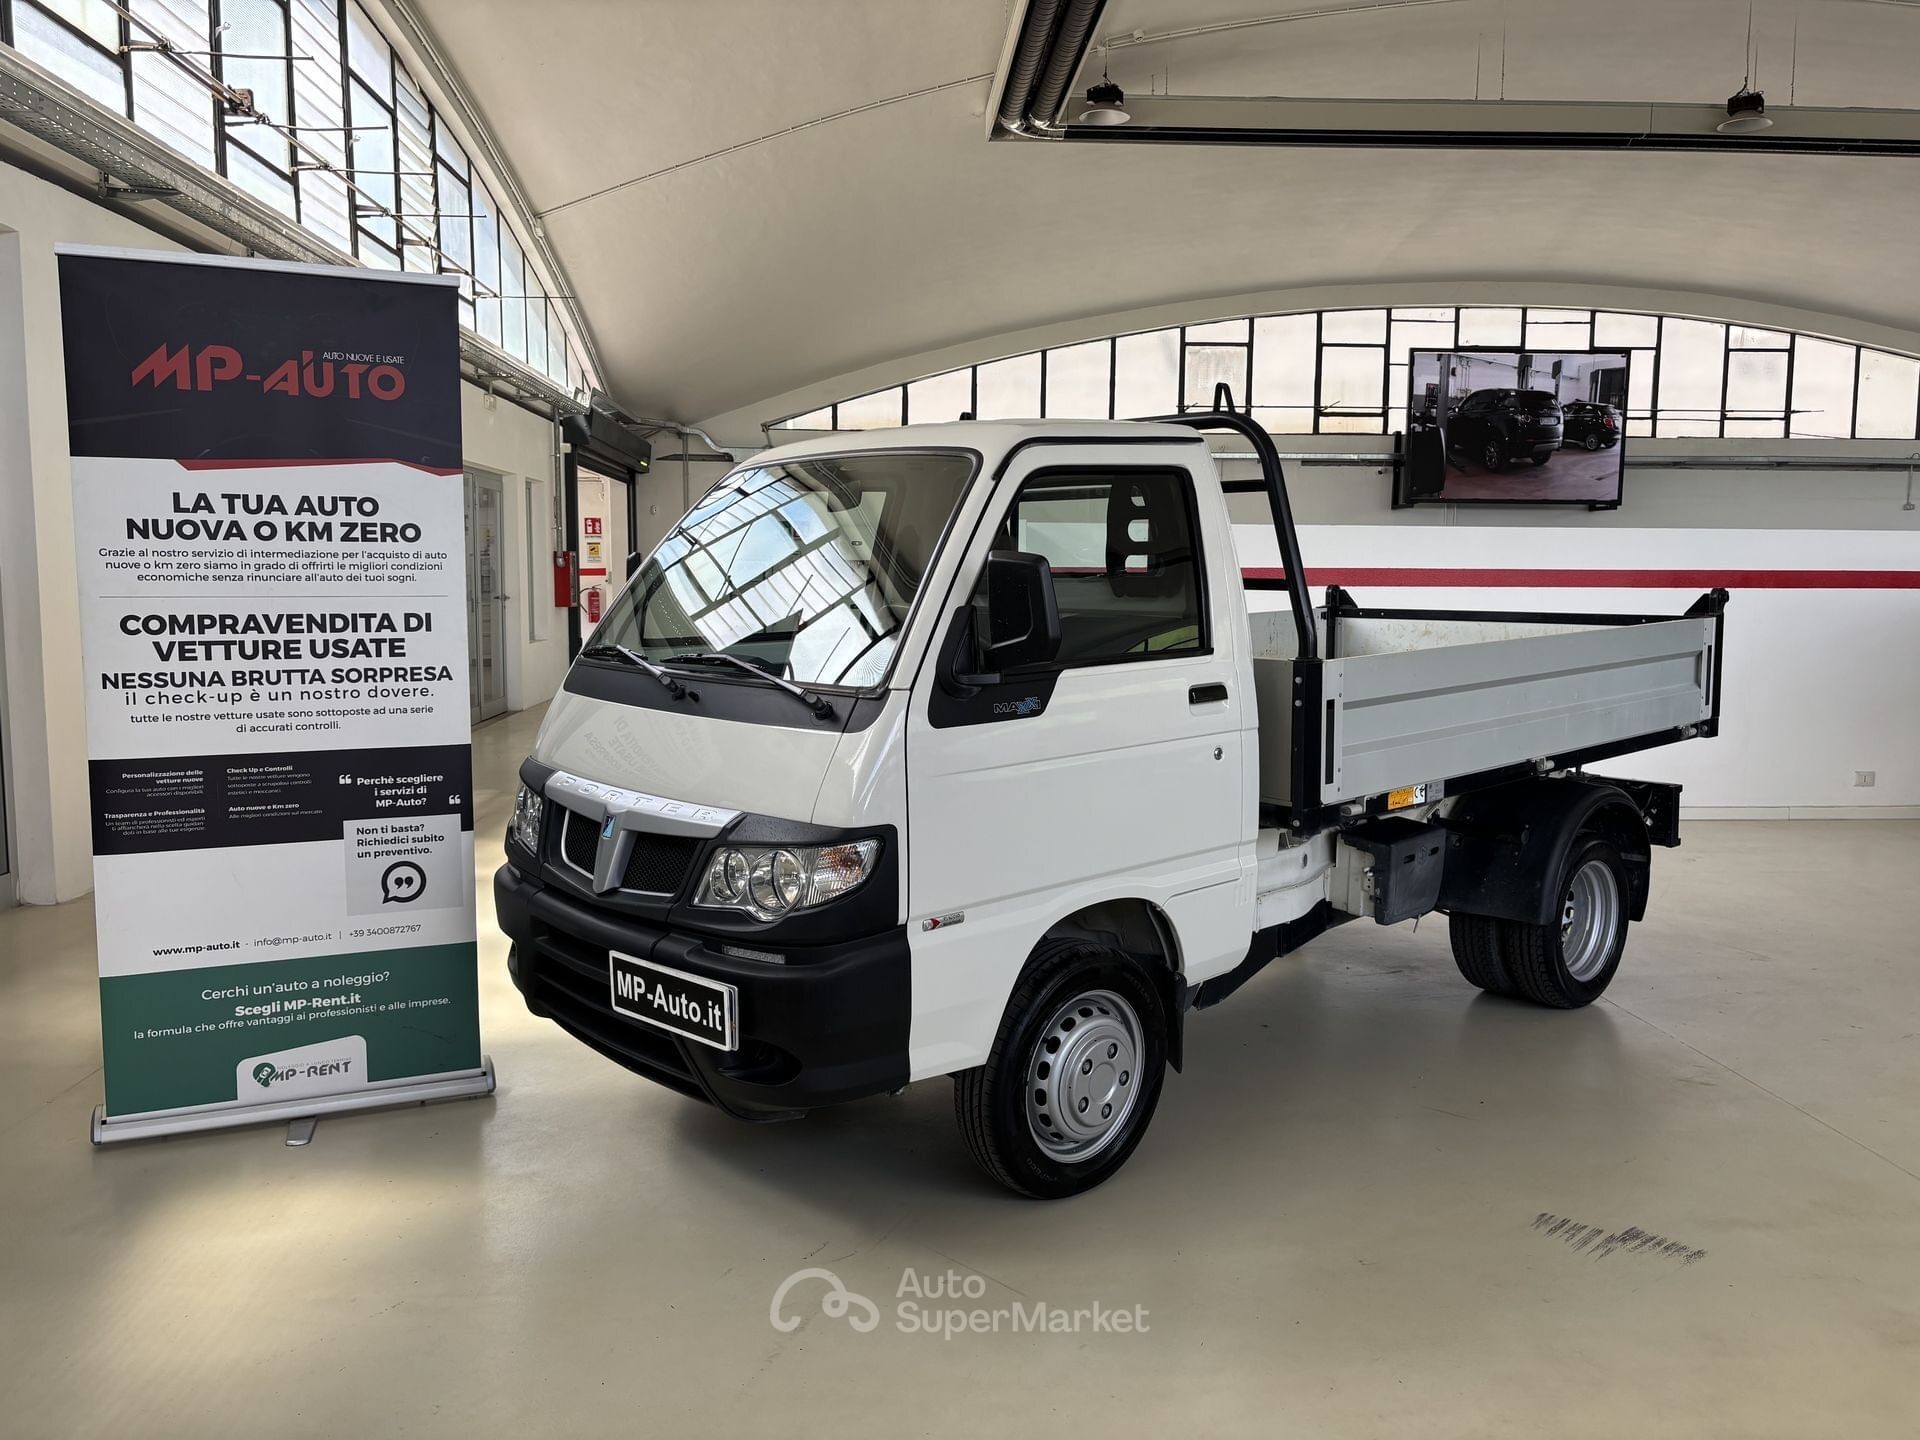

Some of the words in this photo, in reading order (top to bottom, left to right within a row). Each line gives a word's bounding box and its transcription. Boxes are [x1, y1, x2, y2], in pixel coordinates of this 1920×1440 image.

[322, 352, 344, 360] AUTO
[346, 353, 374, 362] NUOVE
[382, 356, 404, 364] USATE
[172, 492, 216, 514] LA
[221, 494, 288, 516] TUA
[294, 496, 379, 517] AUTO
[126, 518, 248, 541] NUOVA
[253, 521, 278, 542] O
[285, 521, 333, 542] KM
[340, 522, 422, 543] ZERO
[99, 548, 136, 557] Grazie
[138, 548, 148, 557] al
[152, 549, 189, 558] nostro
[191, 549, 234, 558] servizio
[237, 549, 247, 558] di
[250, 550, 339, 559] intermediazione
[342, 552, 358, 563] per
[361, 551, 410, 563] l'acquisto
[412, 551, 422, 559] di
[154, 560, 173, 569] km
[203, 561, 237, 570] siamo
[240, 561, 251, 570] in
[254, 561, 286, 572] grado
[288, 562, 299, 570] di
[302, 562, 334, 570] offrirti
[337, 562, 346, 570] le
[349, 562, 388, 572] migliori
[390, 562, 443, 571] condizioni
[137, 572, 209, 582] economiche
[212, 574, 243, 582] senza
[246, 573, 302, 582] rinunciare
[304, 573, 343, 582] all'auto
[346, 573, 361, 582] dei
[365, 573, 385, 582] tuoi
[387, 574, 417, 583] sogni.
[120, 613, 397, 636] COMPRAVENDITA
[404, 612, 432, 632] DI
[152, 640, 302, 661] VETTURE
[309, 638, 406, 659] USATE
[102, 671, 226, 690] NESSUNA
[232, 668, 326, 686] BRUTTA
[331, 666, 453, 684] SORPRESA
[125, 692, 136, 705] il
[145, 690, 242, 705] check-up
[250, 689, 260, 702] è
[268, 691, 292, 701] un
[300, 687, 361, 700] nostro
[367, 686, 434, 699] dovere.
[130, 714, 159, 723] tutte
[162, 714, 172, 722] le
[175, 713, 211, 722] nostre
[214, 711, 253, 721] vetture
[255, 710, 285, 719] usate
[287, 710, 313, 718] sono
[315, 707, 371, 719] sottoposte
[373, 706, 386, 715] ad
[388, 706, 408, 714] una
[410, 705, 434, 714] serie
[236, 724, 246, 733] di
[250, 722, 293, 732] accurati
[296, 721, 341, 731] controlli.
[122, 770, 185, 779] Personalizzazione
[396, 774, 444, 784] scegliere
[374, 787, 378, 796] i
[380, 786, 414, 796] servizi
[416, 786, 427, 794] di
[556, 775, 718, 821] PORTER
[376, 798, 427, 807] MP-Auto?
[356, 826, 378, 835] Non
[380, 825, 388, 833] ti
[391, 824, 425, 833] basta?
[357, 836, 409, 847] Richiedici
[412, 834, 444, 843] subito
[357, 850, 371, 858] un
[374, 846, 432, 858] preventivo.
[153, 941, 240, 956] www.mp-auto.it
[254, 933, 332, 947] info@mp-auto.it
[349, 929, 364, 938] +39
[367, 924, 422, 937] 3400872767
[202, 985, 249, 1000] Cerchi
[253, 980, 308, 994] un'auto
[312, 980, 320, 989] a
[324, 971, 390, 987] noleggio?
[235, 1001, 280, 1017] Scegli
[284, 993, 361, 1012] MP-Rent.it
[616, 970, 723, 1032] MP-Auto.it
[134, 1031, 144, 1039] la
[148, 1026, 192, 1038] formula
[195, 1022, 216, 1032] che
[218, 1020, 244, 1030] offre
[246, 1012, 294, 1026] vantaggi
[296, 1011, 305, 1021] ai
[309, 1004, 376, 1021] professionisti
[388, 1001, 406, 1010] alle
[408, 998, 451, 1010] imprese.
[270, 1061, 352, 1081] MP-RENT
